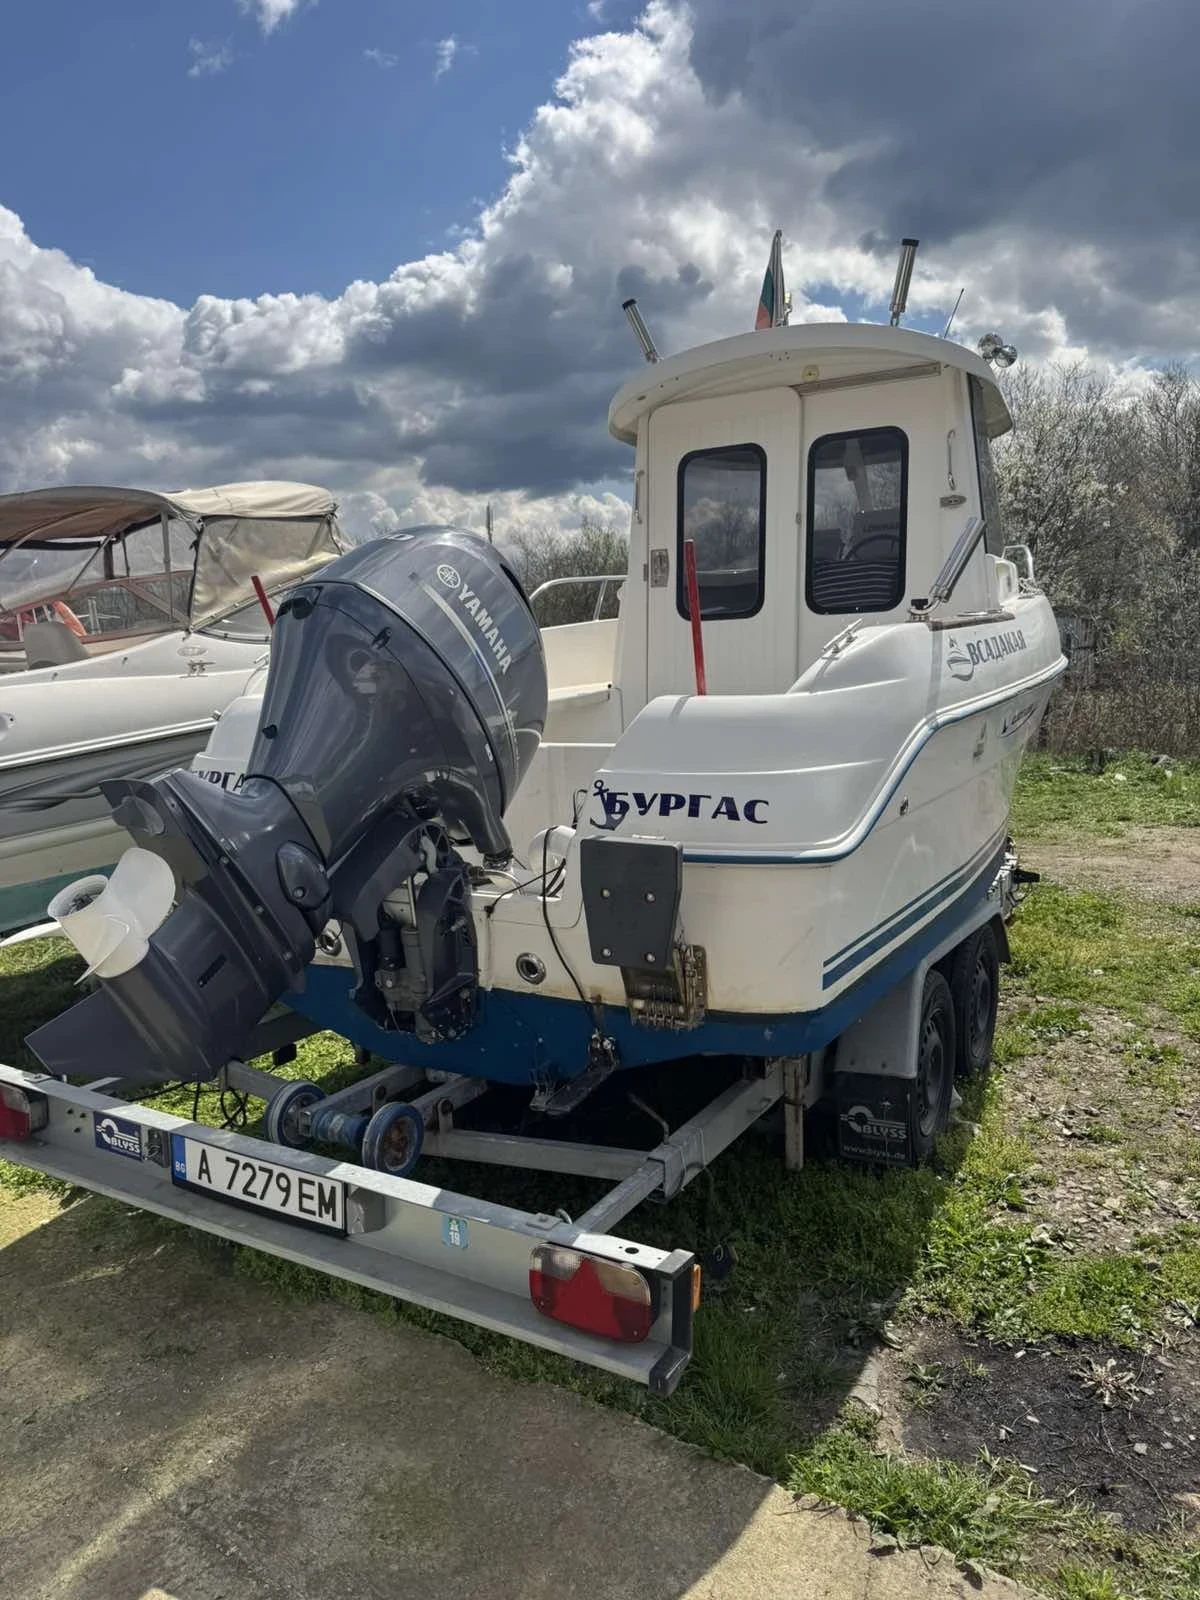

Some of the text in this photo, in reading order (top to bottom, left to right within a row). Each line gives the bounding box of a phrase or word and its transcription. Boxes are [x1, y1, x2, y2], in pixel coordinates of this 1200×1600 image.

[458, 583, 512, 675] YAMAHA
[606, 791, 769, 824] БУРГАС
[862, 1124, 907, 1139] BLYSS
[111, 1136, 140, 1153] BLYSS
[175, 1160, 185, 1173] BG
[197, 1148, 212, 1184] A
